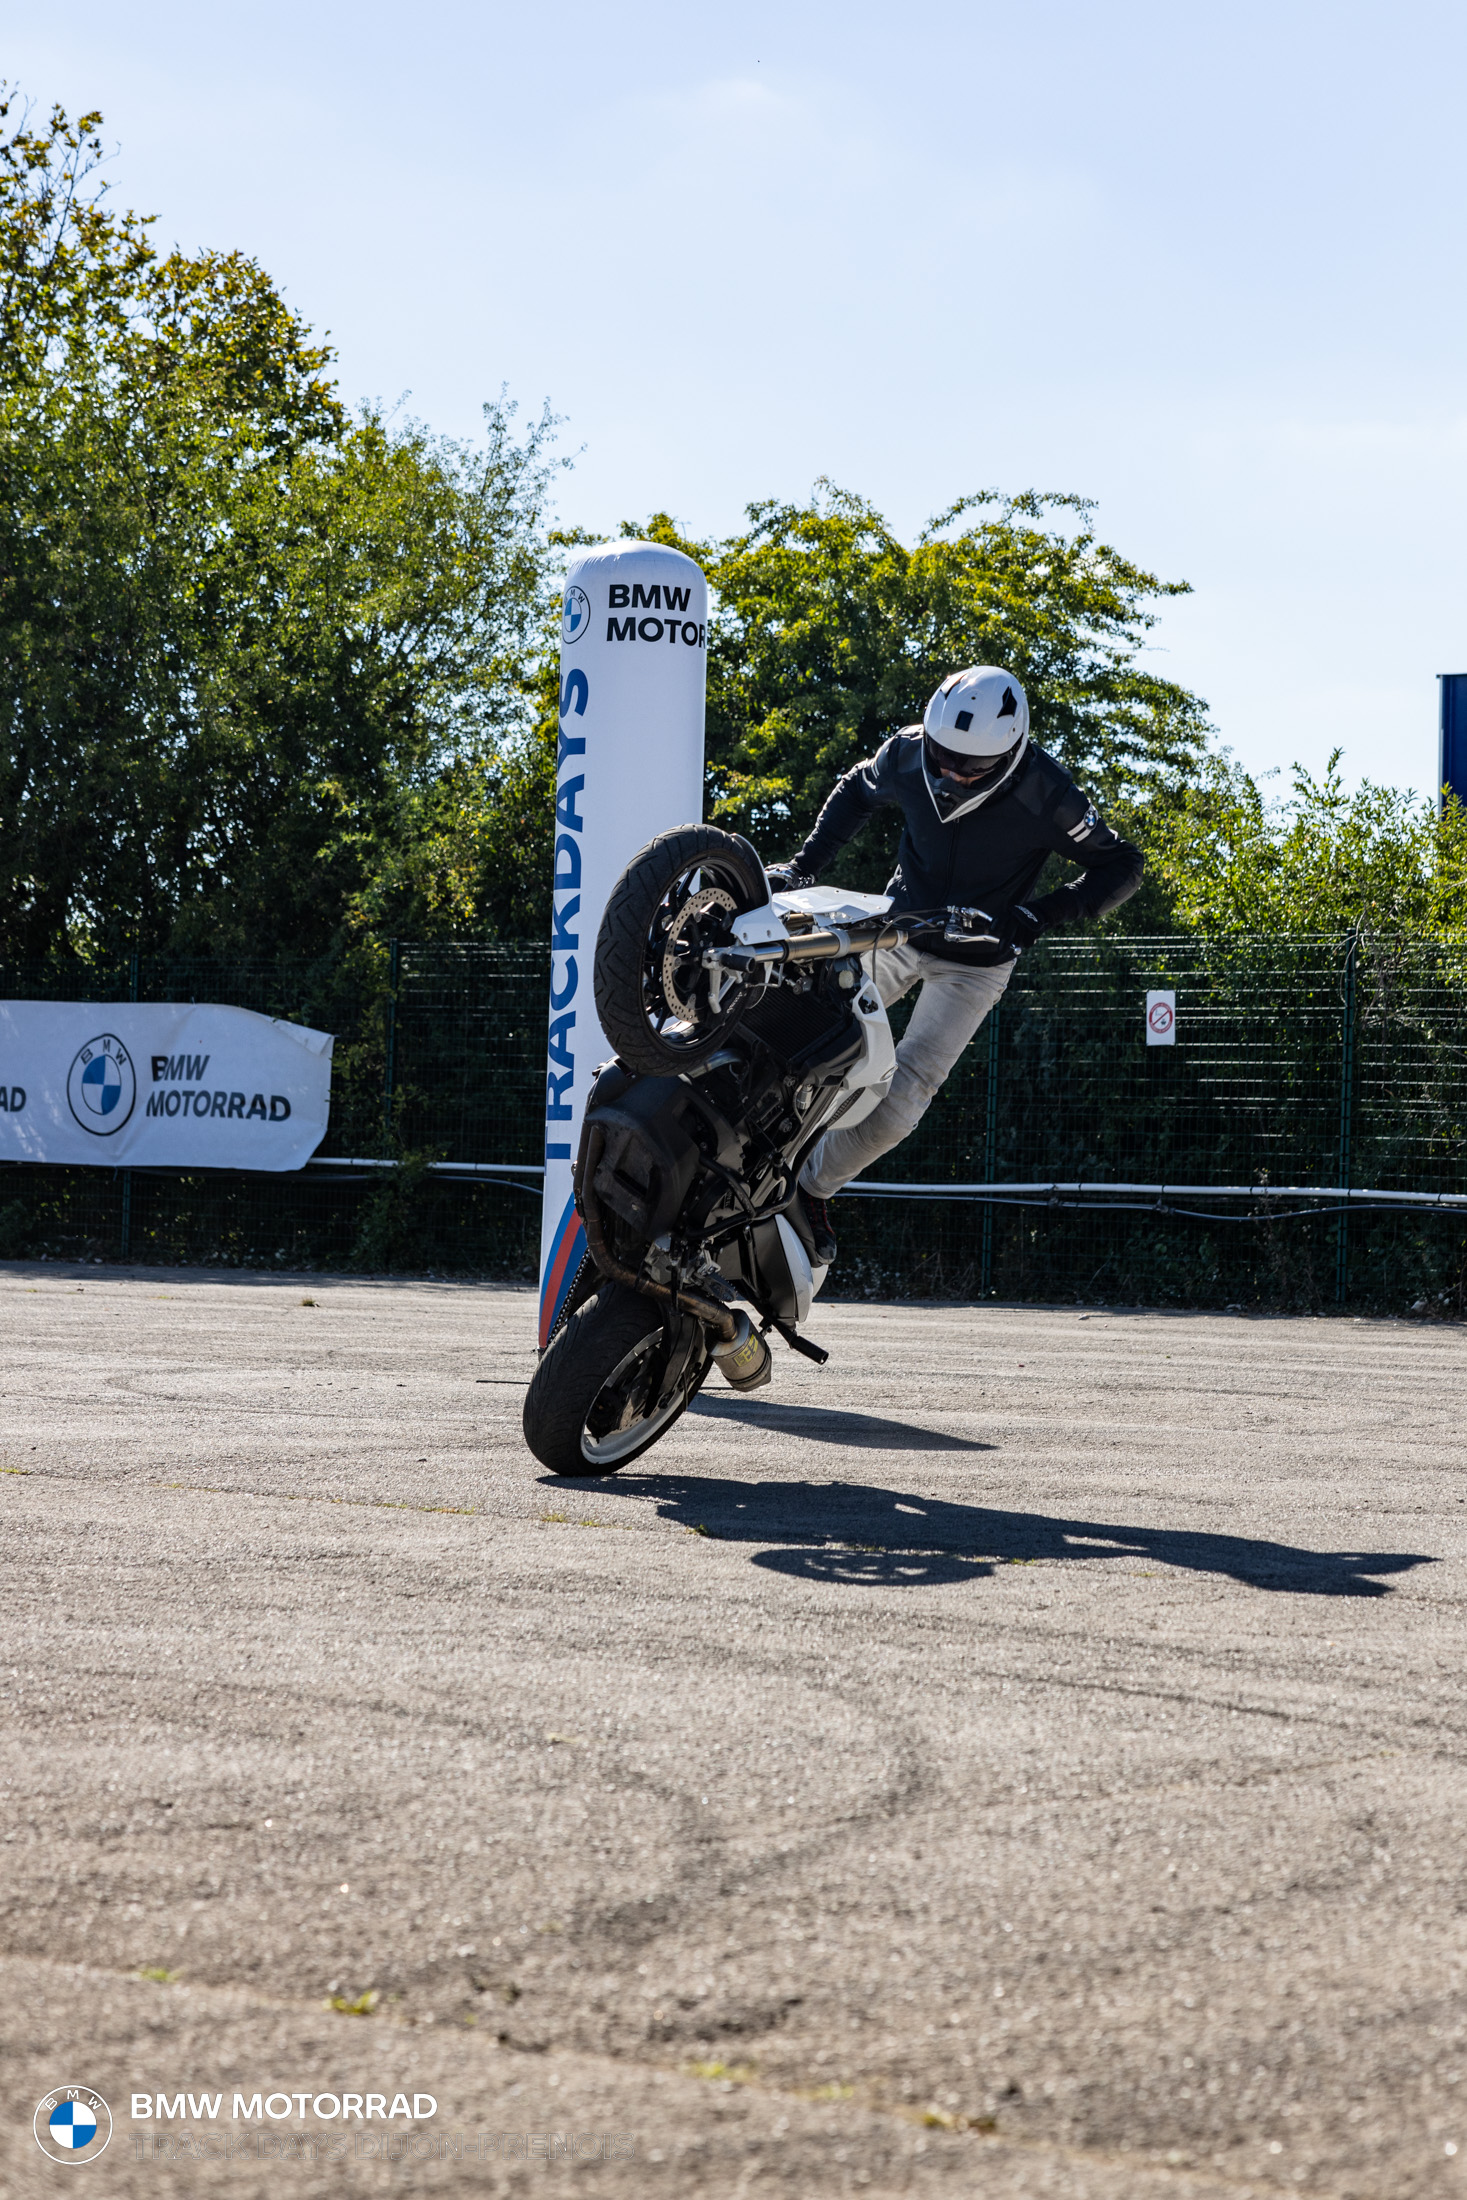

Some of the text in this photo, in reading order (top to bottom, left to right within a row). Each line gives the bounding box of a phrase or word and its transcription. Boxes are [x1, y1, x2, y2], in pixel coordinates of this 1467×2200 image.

[608, 583, 691, 612] BMW
[80, 1038, 127, 1066] BMW
[151, 1055, 210, 1082] BMW
[146, 1090, 291, 1122] MOTORRAD
